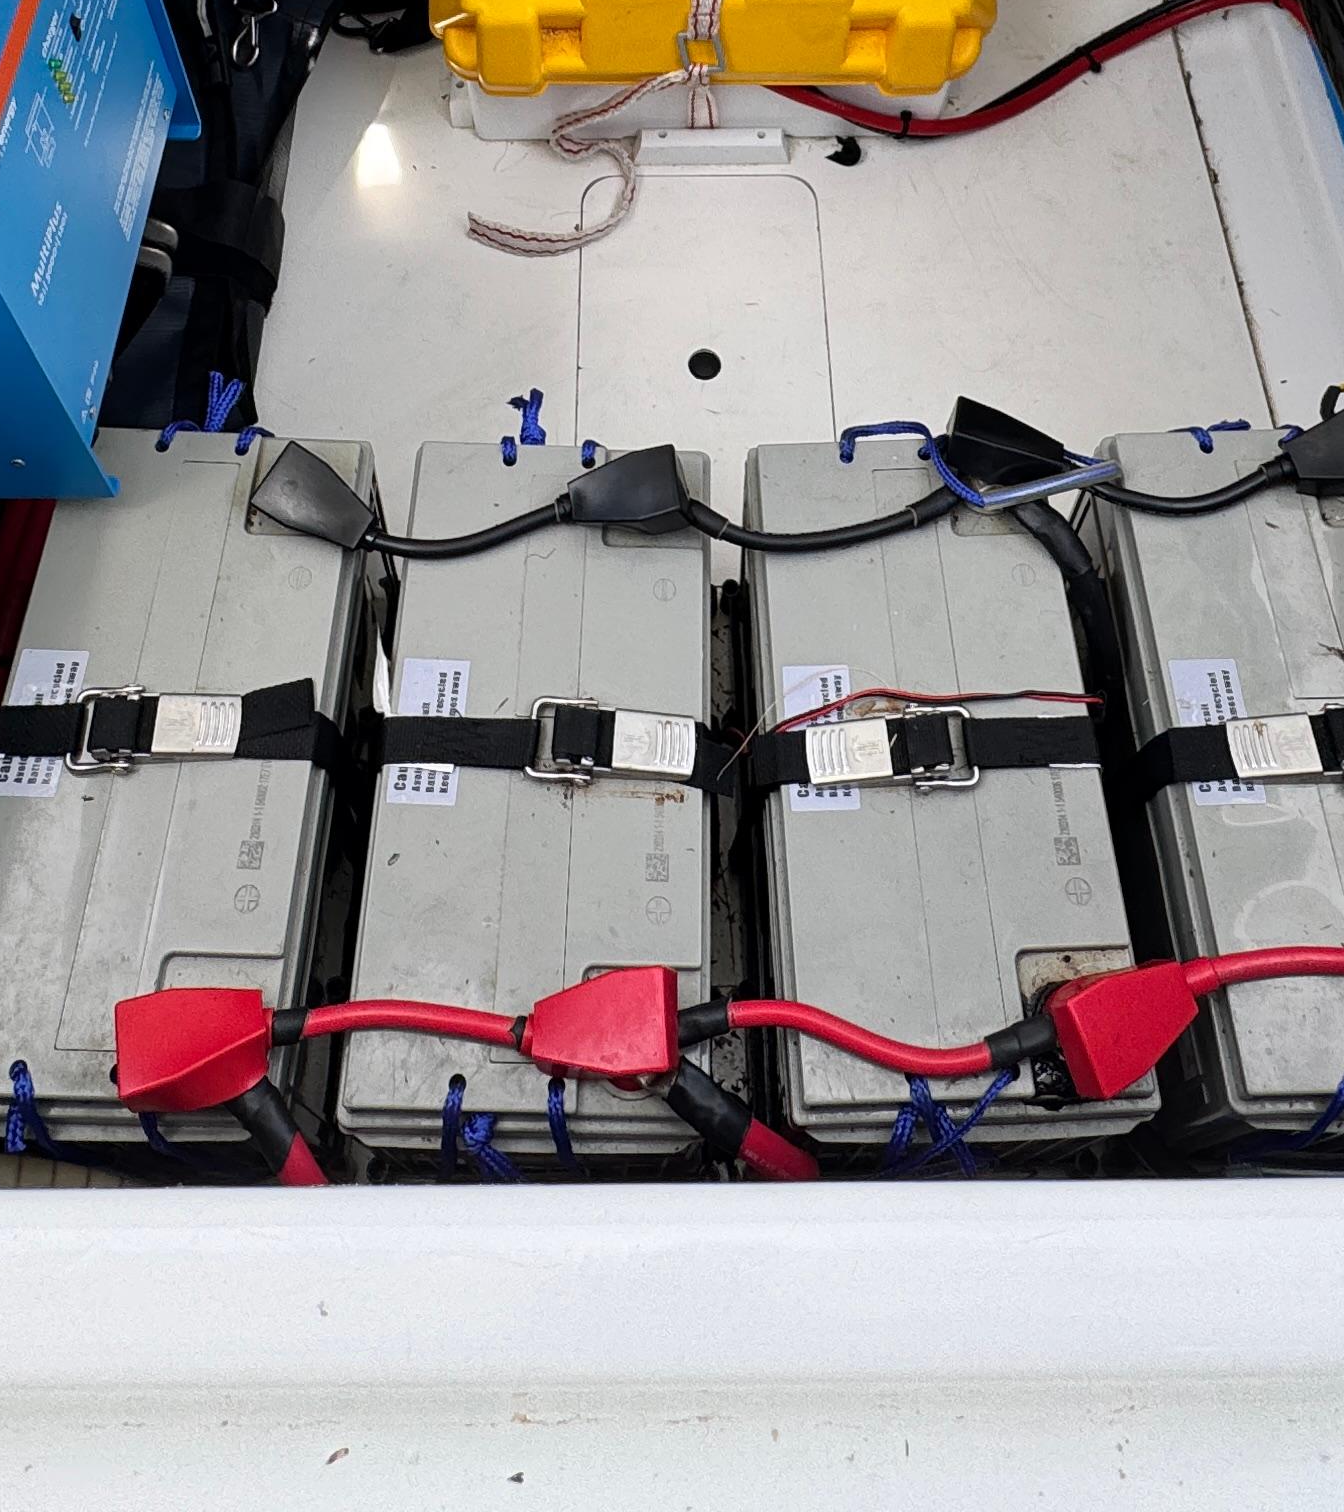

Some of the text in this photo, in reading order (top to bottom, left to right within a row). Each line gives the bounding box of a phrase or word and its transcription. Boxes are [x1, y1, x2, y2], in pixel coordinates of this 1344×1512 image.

[31, 200, 63, 297] MultiPlus
[436, 672, 447, 714] recycled
[1207, 672, 1224, 714] recycled
